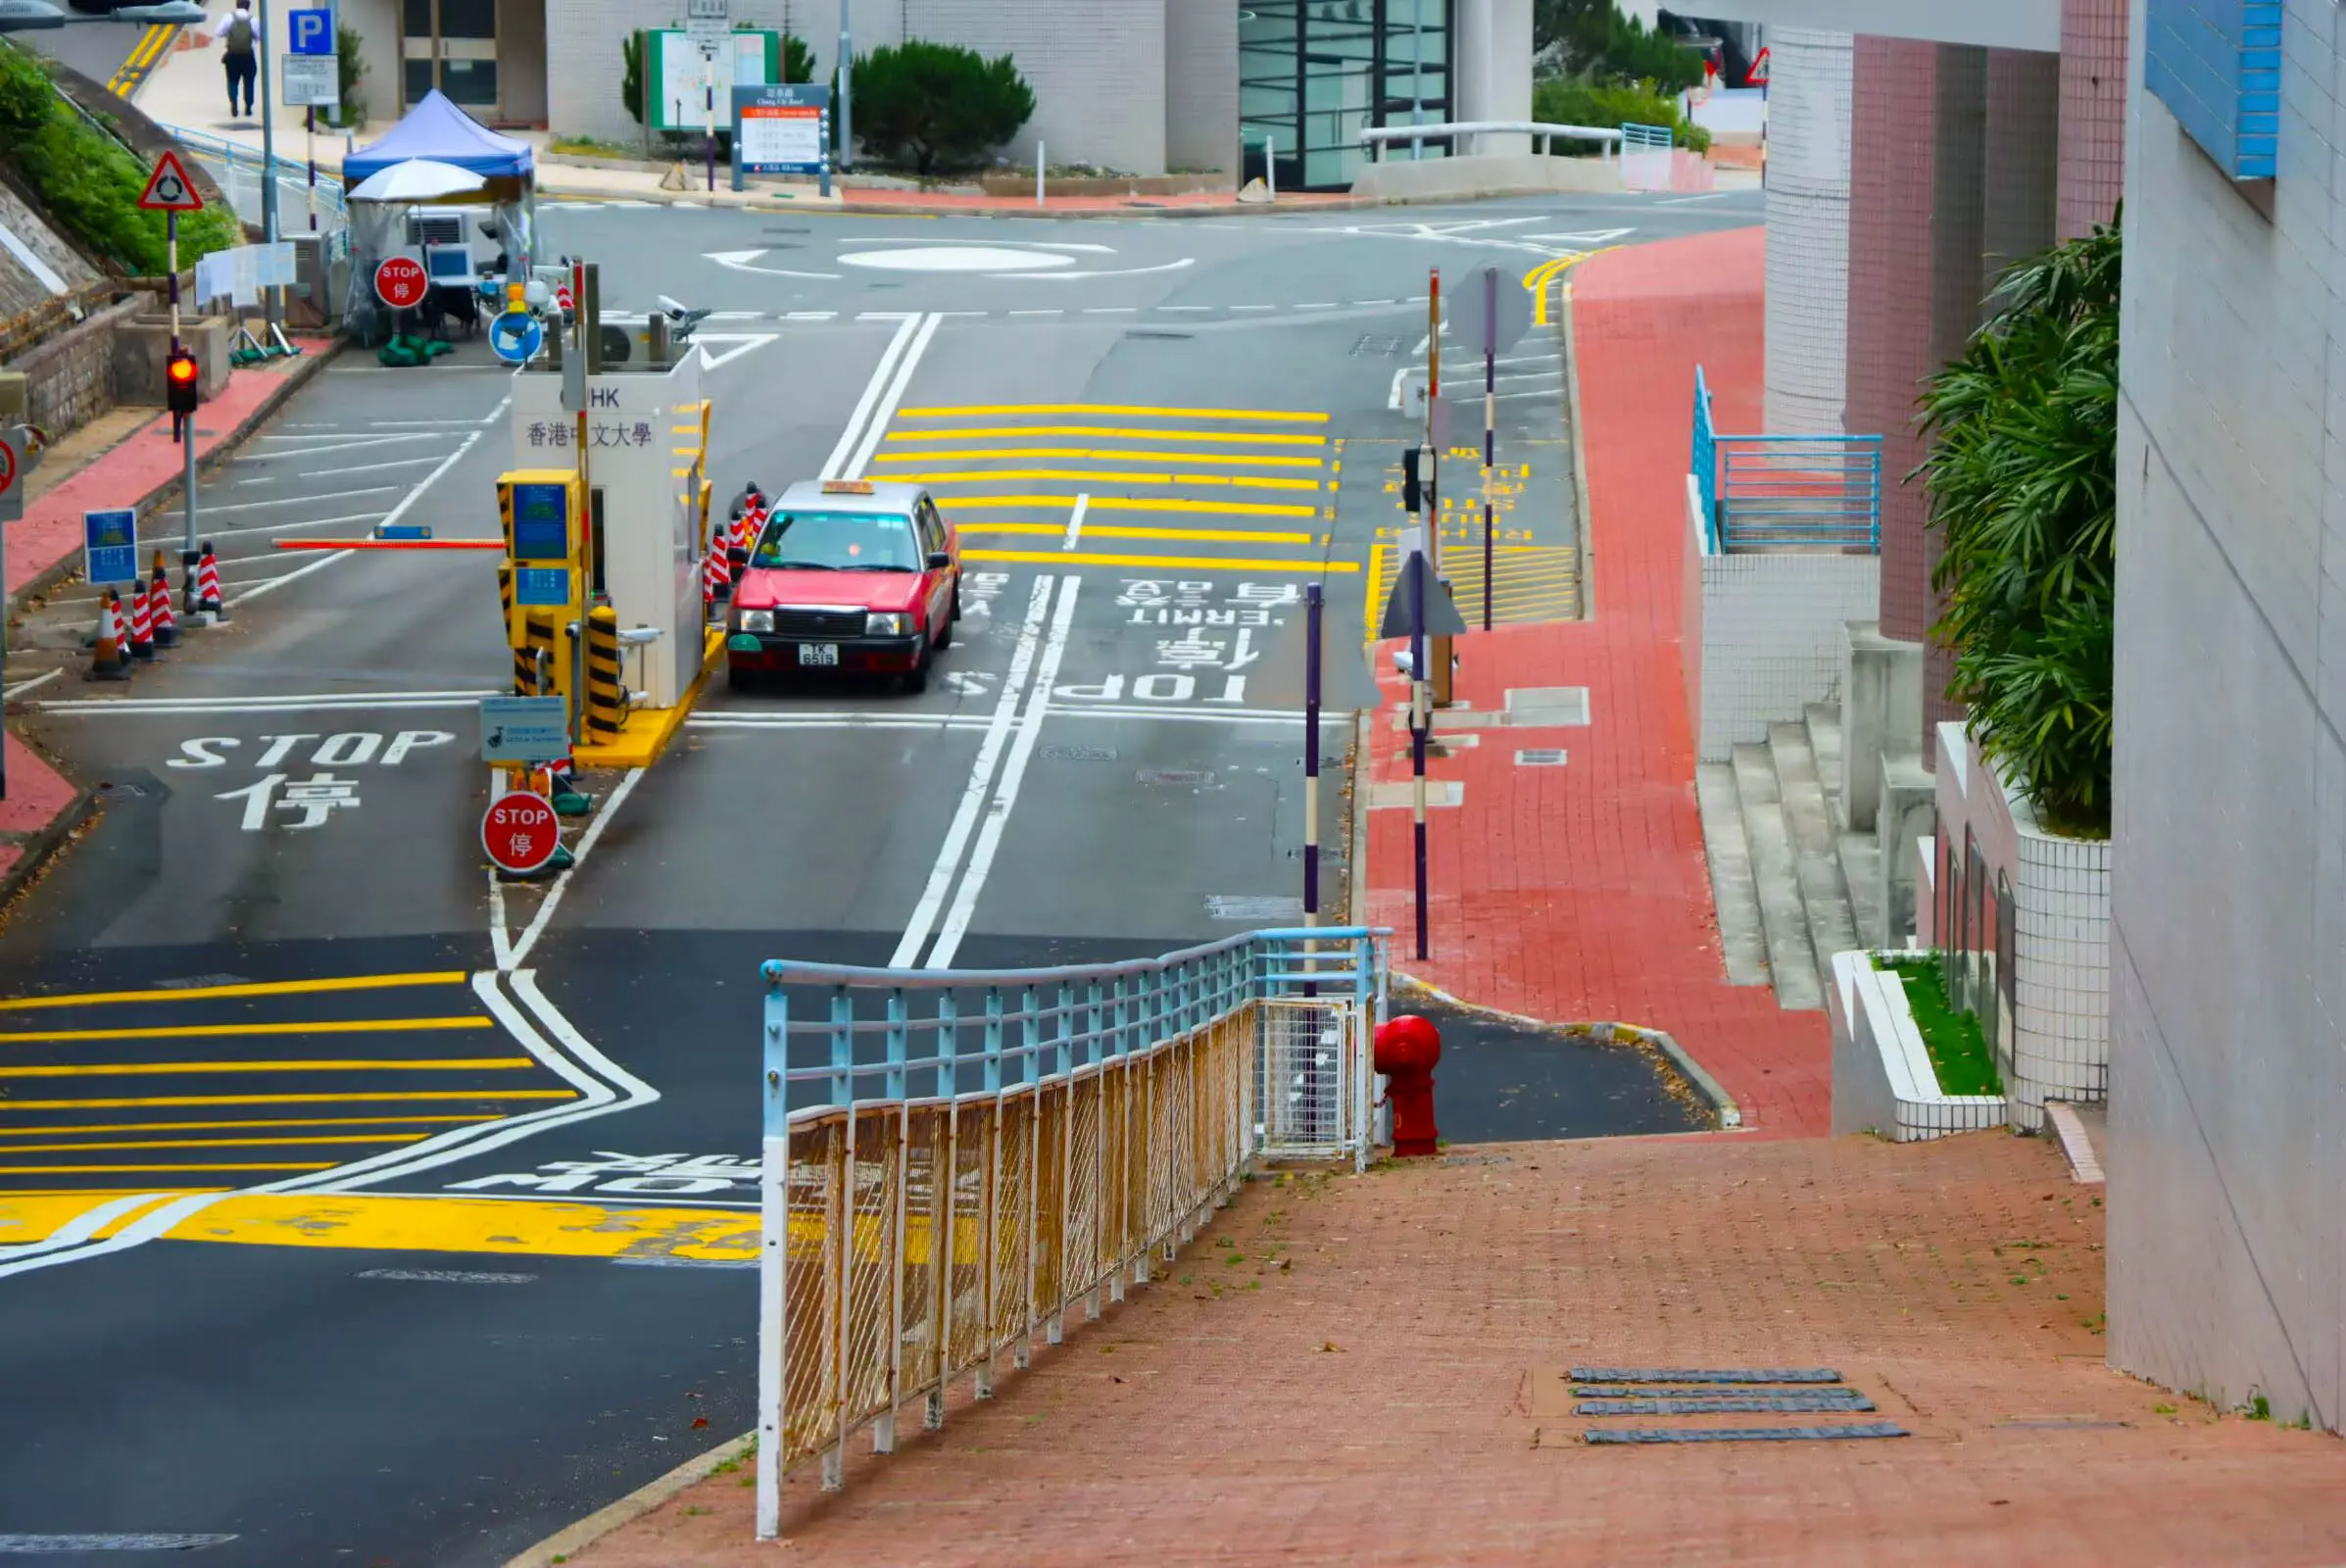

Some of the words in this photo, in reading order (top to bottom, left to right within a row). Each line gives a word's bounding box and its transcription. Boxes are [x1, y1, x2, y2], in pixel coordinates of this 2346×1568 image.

[298, 15, 322, 47] P
[382, 267, 419, 278] STOP
[394, 282, 410, 299] 停
[1125, 609, 1286, 627] ERMIT
[1155, 627, 1260, 670] 停
[1051, 673, 1247, 705] TOP
[166, 730, 457, 767] STOP
[213, 772, 362, 830] 停
[494, 808, 550, 825] STOP
[510, 832, 533, 858] 停
